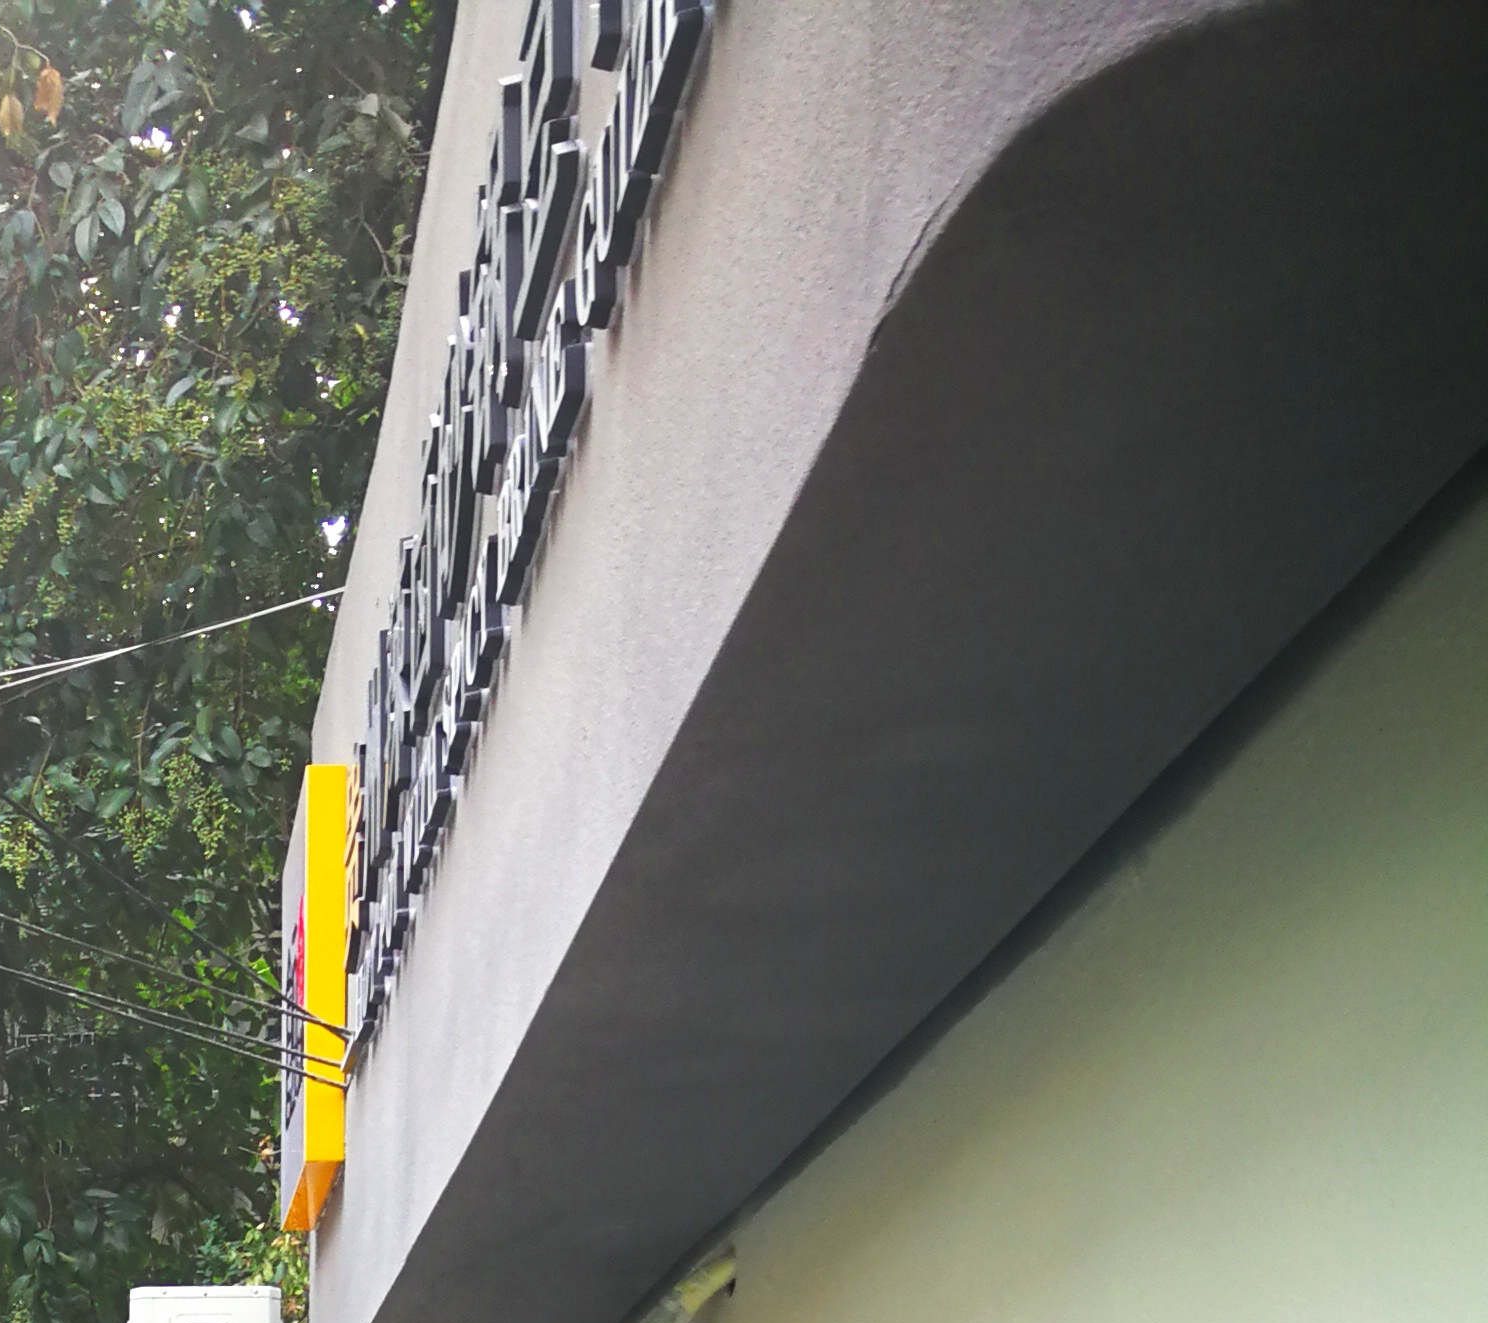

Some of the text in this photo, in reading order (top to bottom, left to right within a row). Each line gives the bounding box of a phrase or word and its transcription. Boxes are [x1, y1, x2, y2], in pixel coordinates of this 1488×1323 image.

[343, 0, 602, 972] 贵州辣卤砂锅豆
[403, 716, 441, 892] WITH
[443, 541, 489, 768] SPICY
[496, 284, 566, 603] BRINE
